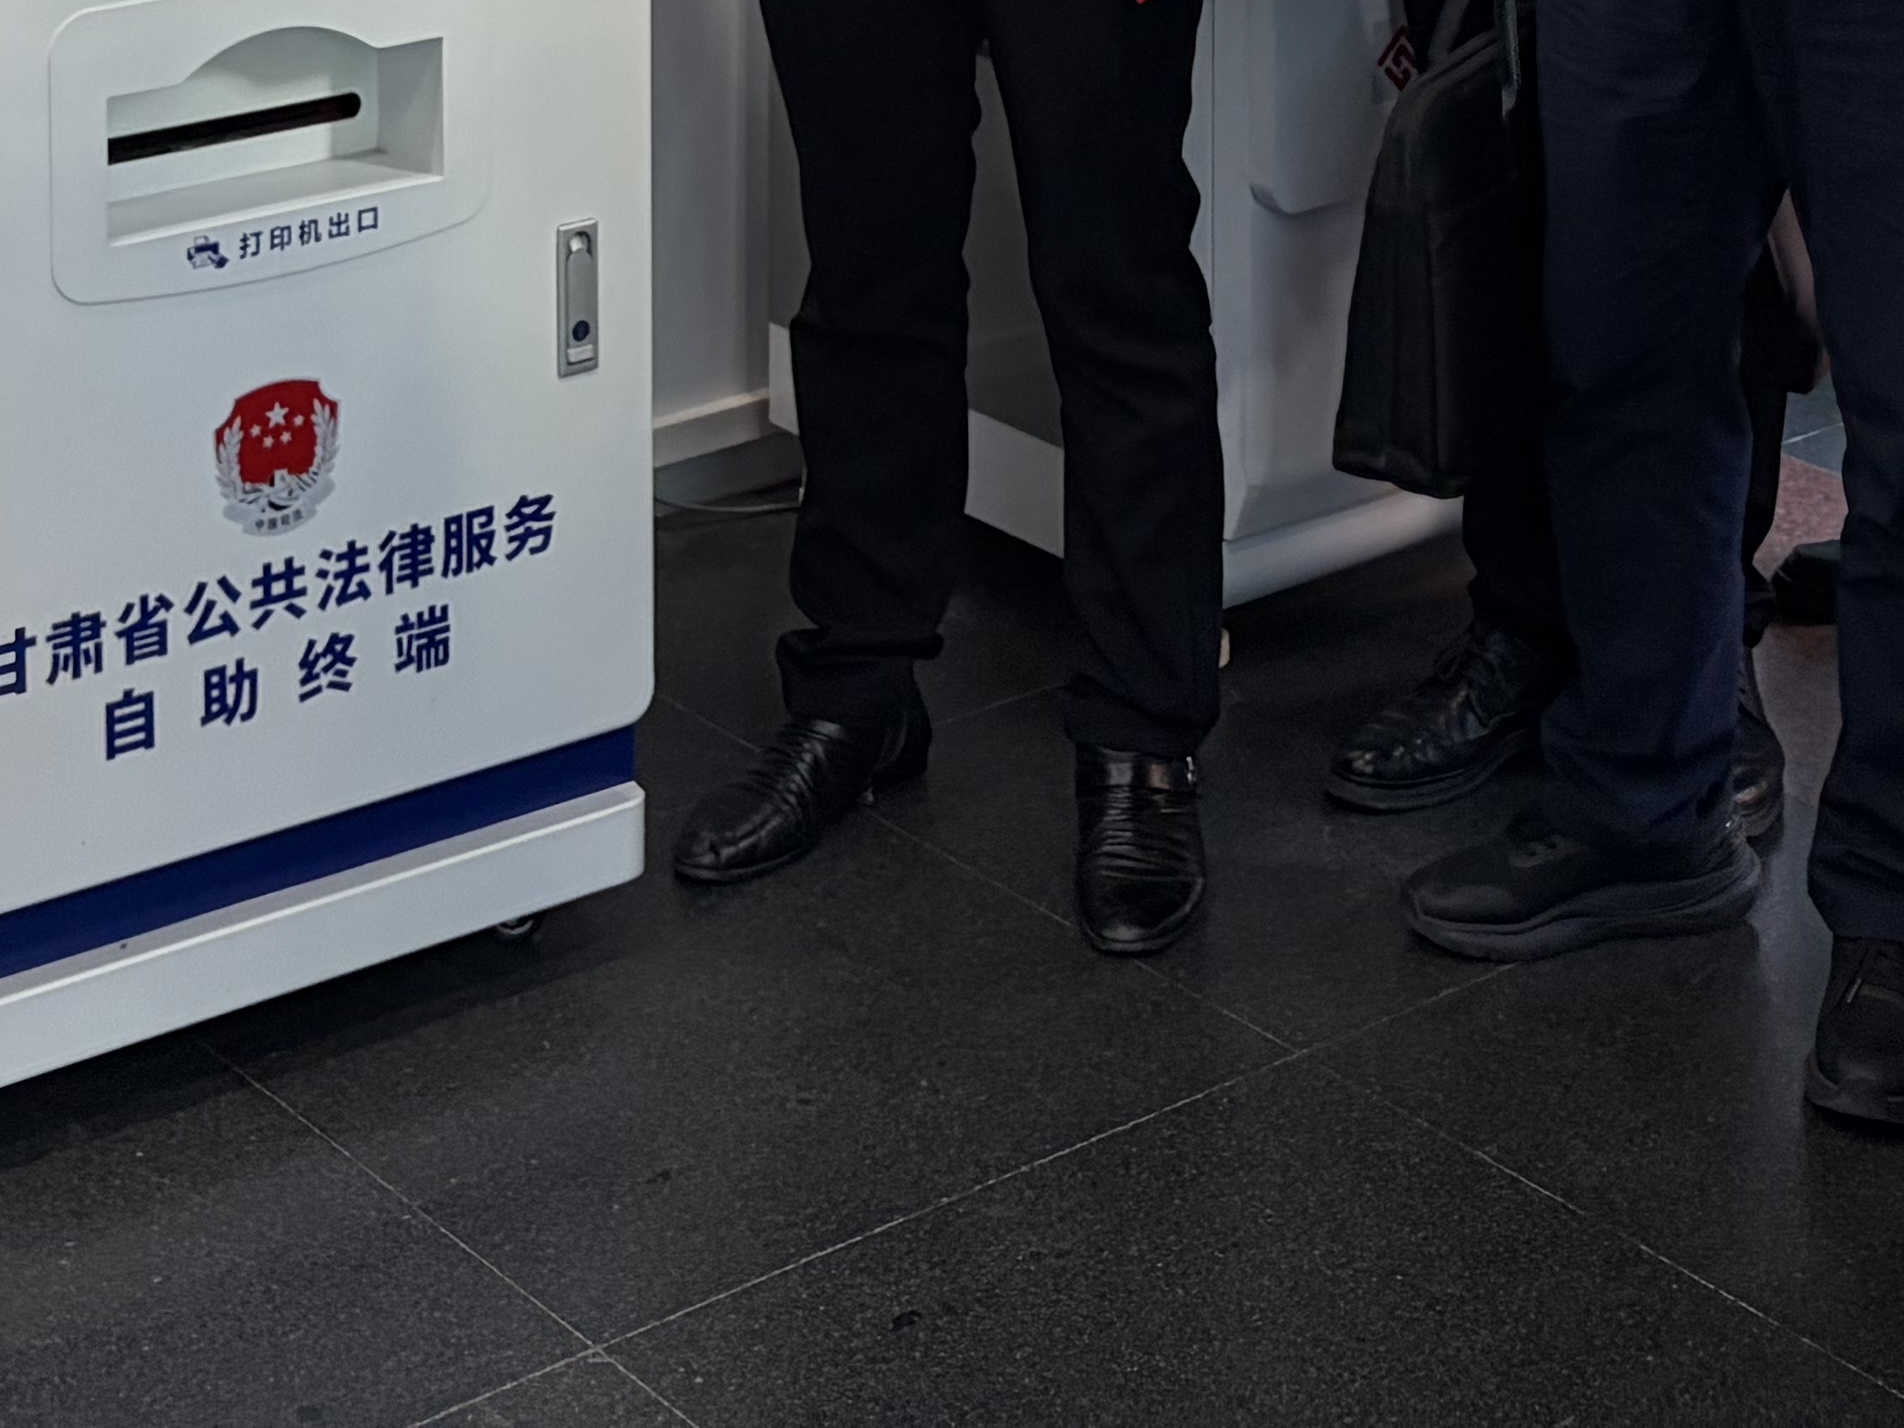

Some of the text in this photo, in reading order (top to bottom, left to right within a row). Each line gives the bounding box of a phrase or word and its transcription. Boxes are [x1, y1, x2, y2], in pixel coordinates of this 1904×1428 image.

[238, 206, 380, 261] 打印机出口
[104, 604, 453, 761] 自助终端
